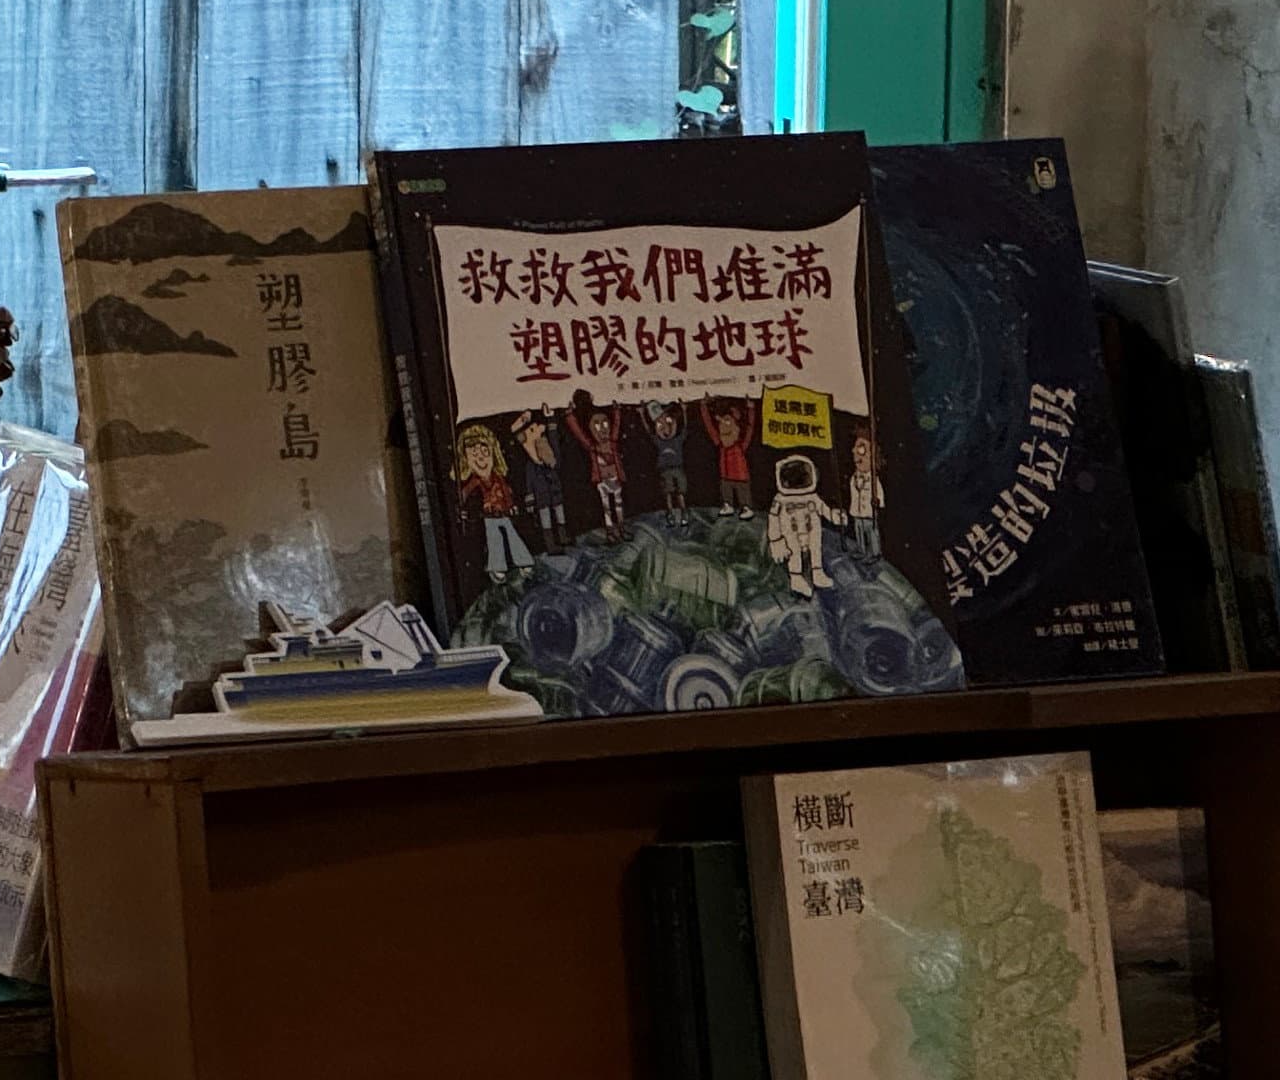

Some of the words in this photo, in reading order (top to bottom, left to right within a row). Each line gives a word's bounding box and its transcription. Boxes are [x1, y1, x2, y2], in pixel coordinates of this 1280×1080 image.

[458, 242, 833, 308] 救救我們堆滿
[256, 273, 320, 460] 塑膠島
[510, 307, 815, 383] 塑膠的地球
[793, 789, 855, 832] 橫斷
[797, 837, 861, 855] Traverse
[800, 856, 851, 874] Taiwan
[803, 876, 865, 919] 臺灣
